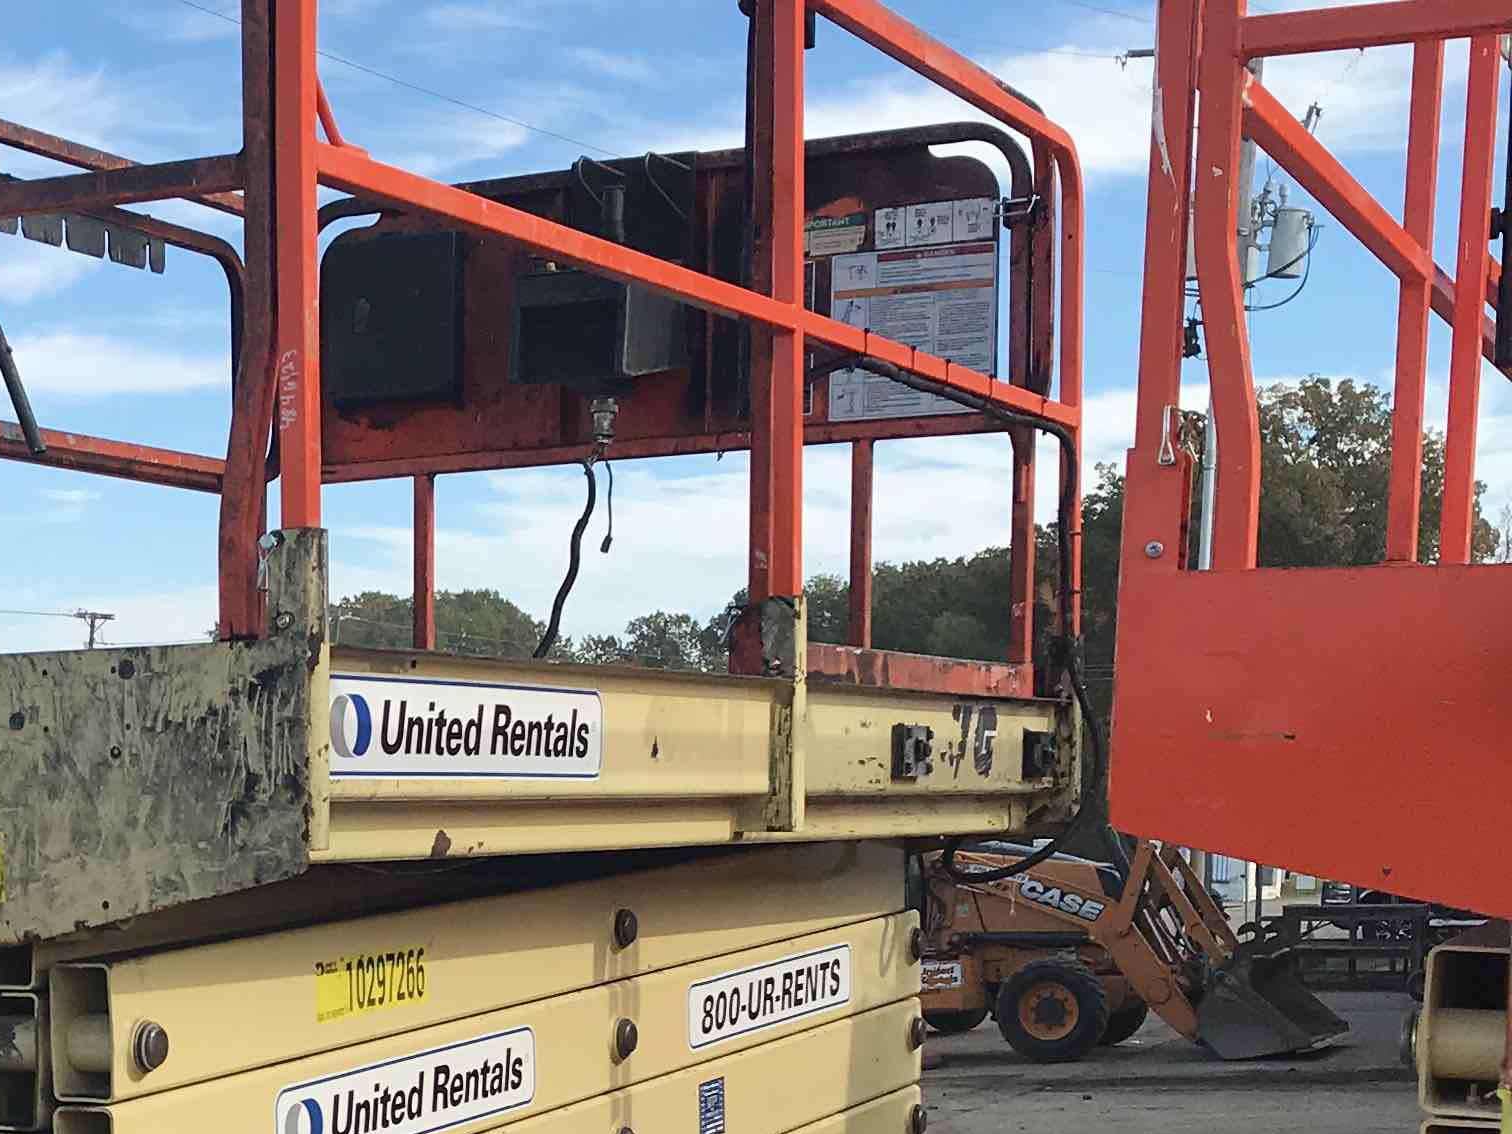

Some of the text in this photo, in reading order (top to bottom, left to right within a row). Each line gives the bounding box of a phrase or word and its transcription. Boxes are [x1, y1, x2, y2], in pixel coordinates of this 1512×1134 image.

[380, 699, 590, 759] United Rentals
[1020, 879, 1105, 922] CASE
[345, 947, 425, 1012] 10297266
[701, 958, 841, 1034] 800-UR-RENTS
[432, 1047, 524, 1113] Rentals
